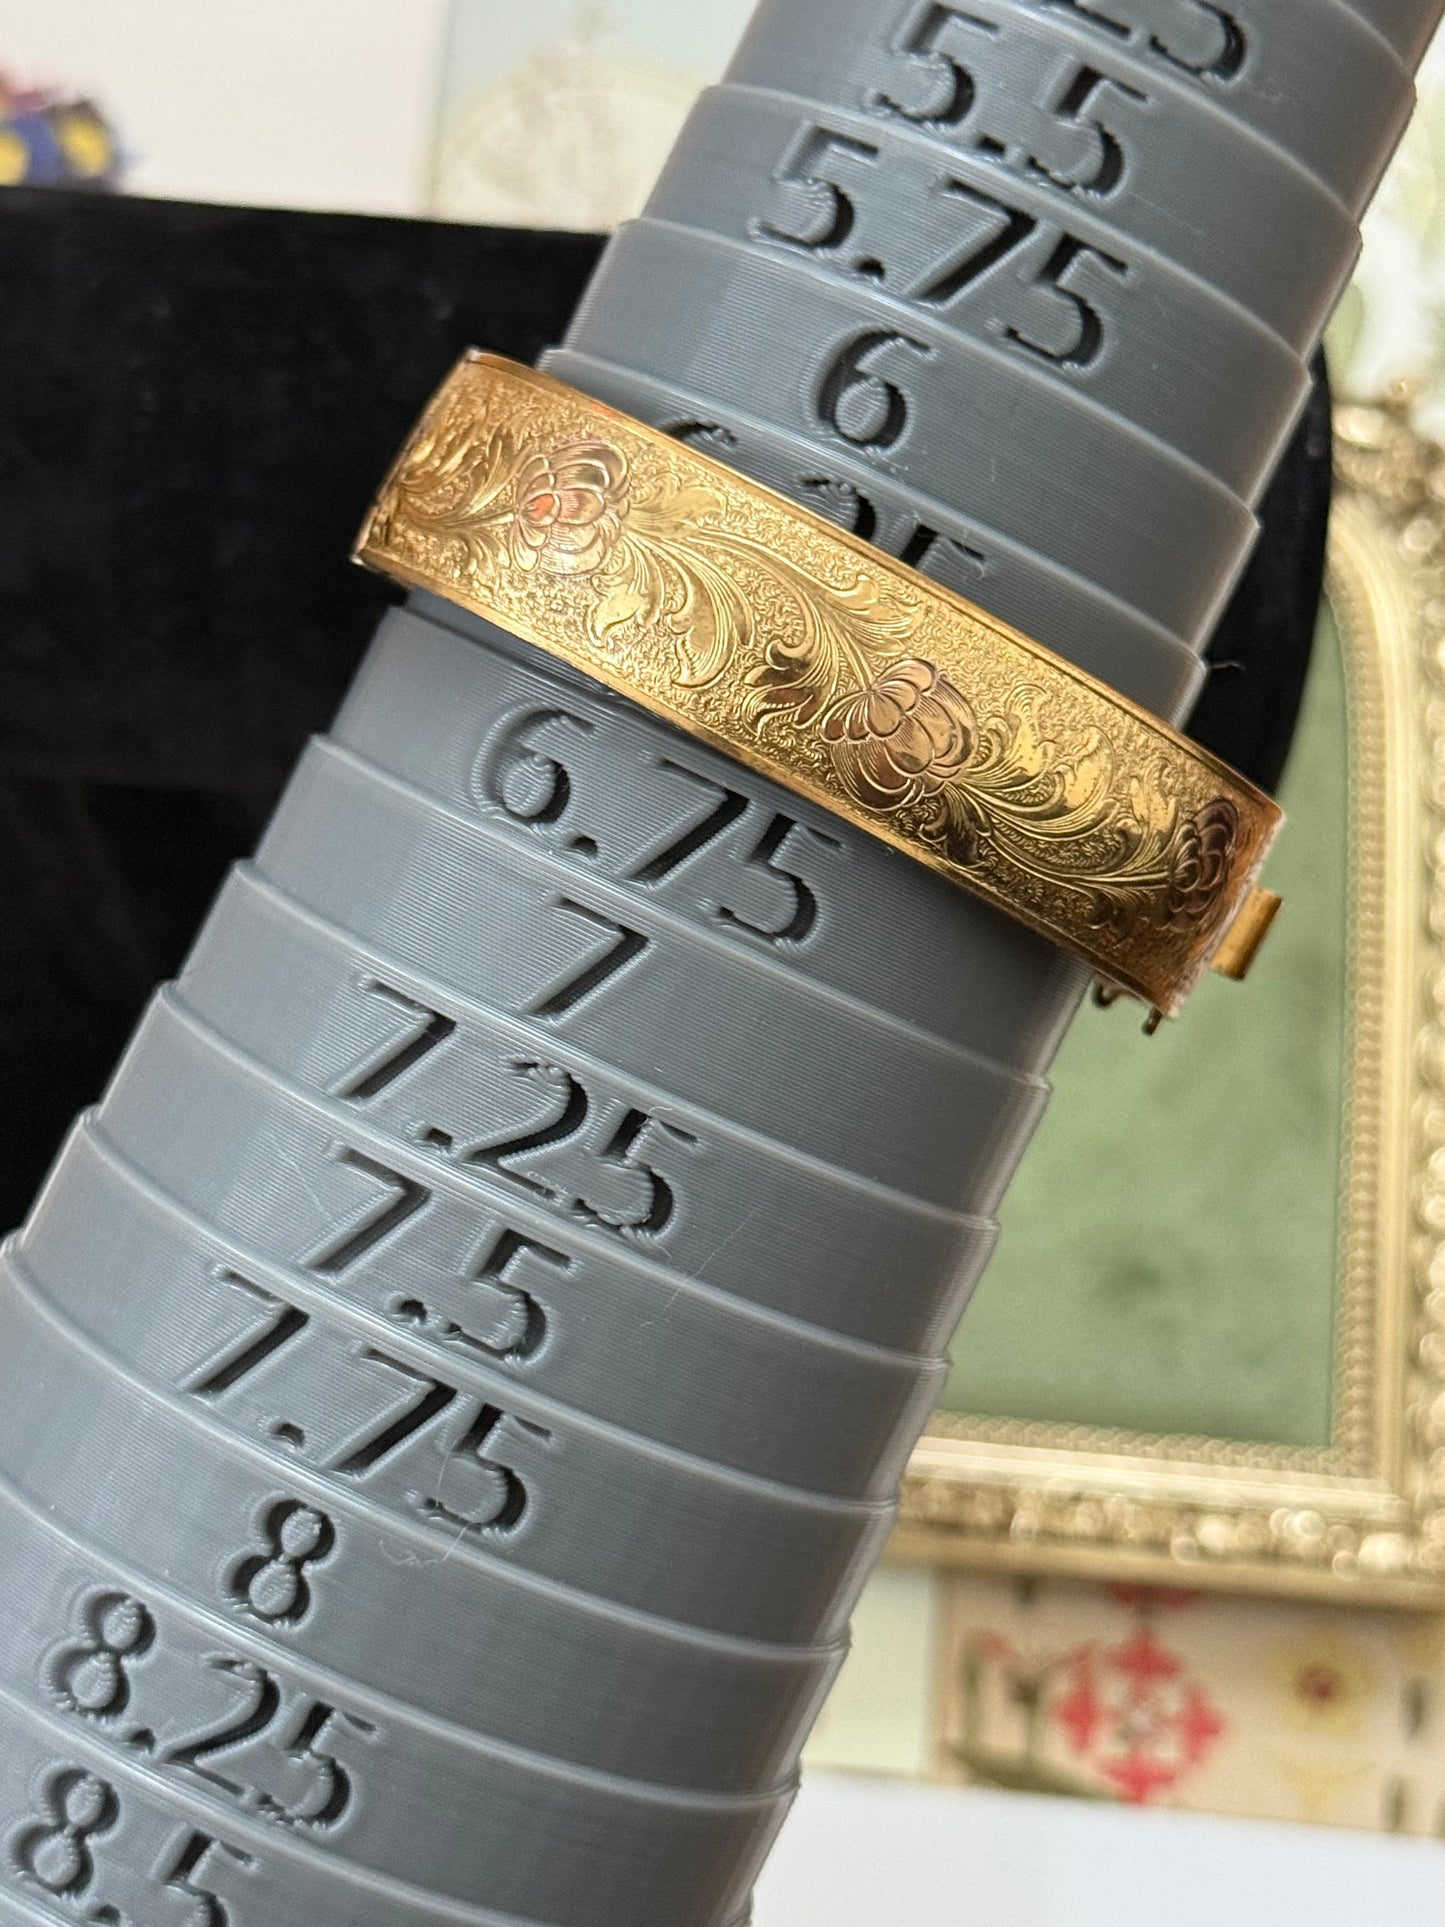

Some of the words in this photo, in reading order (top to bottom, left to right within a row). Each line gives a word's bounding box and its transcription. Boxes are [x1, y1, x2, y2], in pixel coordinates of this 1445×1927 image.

[868, 0, 1151, 202] 5.5
[750, 122, 1131, 374] 5.75
[806, 323, 938, 456] 6
[474, 705, 842, 948] 6.75
[542, 890, 653, 1028] 7
[326, 973, 702, 1240] 7.25
[300, 1142, 576, 1366] 7.5
[177, 1266, 558, 1538] 7.75
[222, 1492, 338, 1628] 8
[40, 1583, 380, 1830] 8.25
